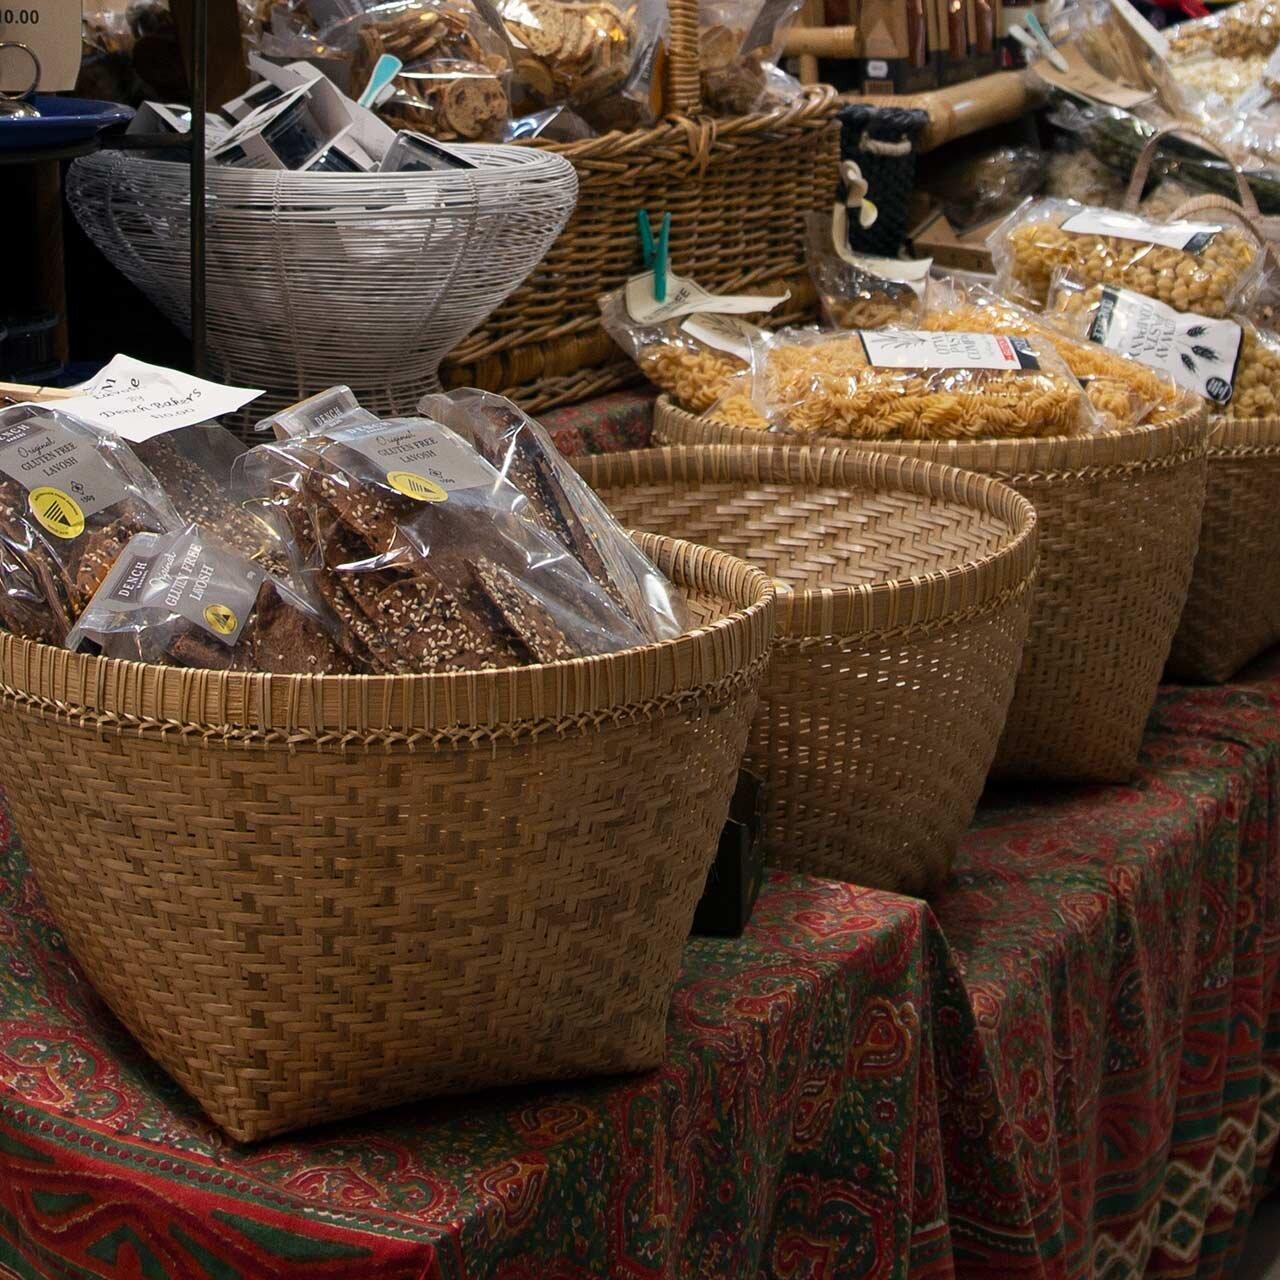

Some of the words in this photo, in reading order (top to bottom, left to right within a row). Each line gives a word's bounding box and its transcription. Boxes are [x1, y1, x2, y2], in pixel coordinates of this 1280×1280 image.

[314, 406, 344, 426] DENCH
[17, 436, 56, 458] Original
[375, 430, 417, 447] Original
[377, 443, 414, 458] GLUTEN
[413, 436, 439, 450] FREE
[20, 449, 57, 472] GLUTEN
[56, 441, 78, 457] FREE
[43, 456, 79, 477] LAVOSH
[399, 449, 438, 464] LAVOSH
[149, 551, 177, 589] Original
[183, 543, 203, 575] FREE
[118, 561, 147, 598] DENCH
